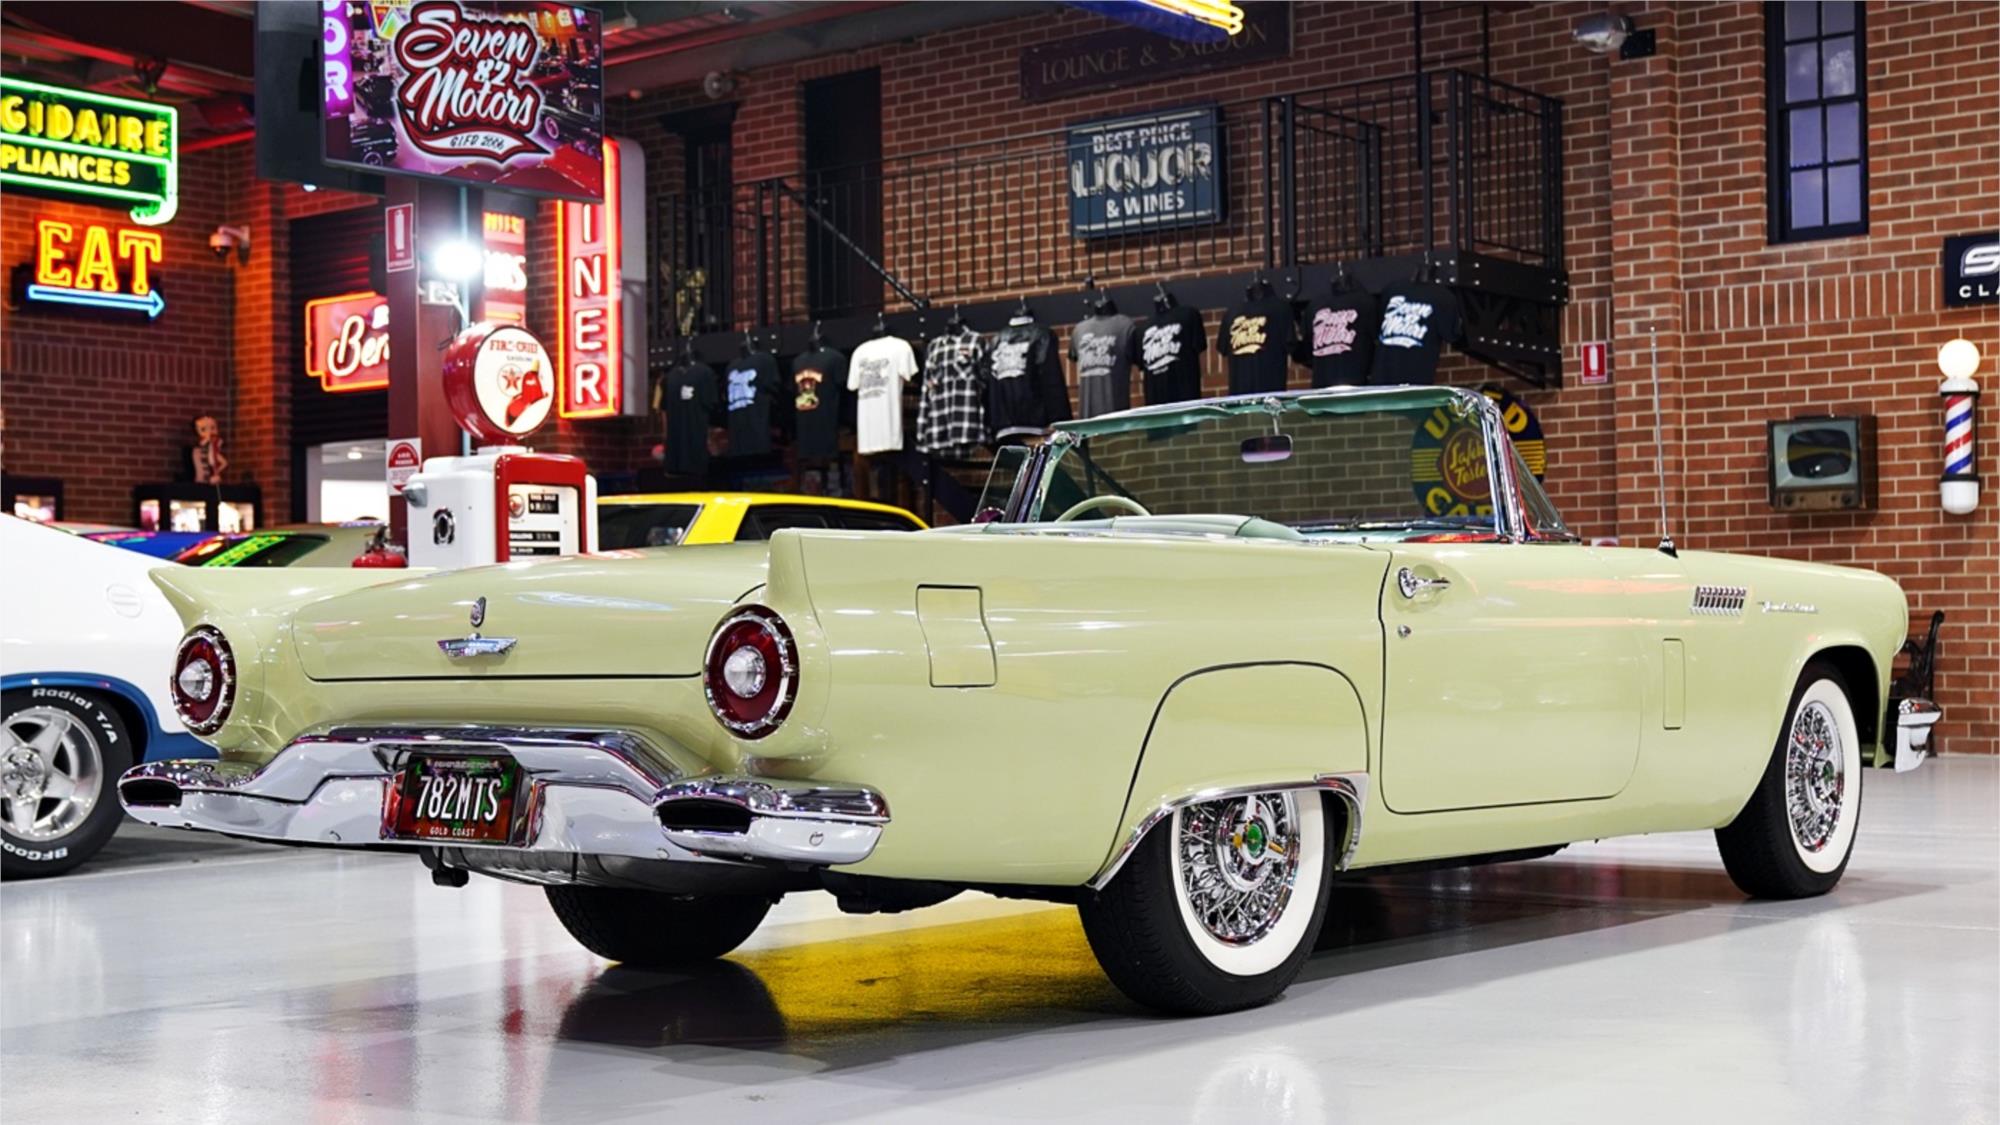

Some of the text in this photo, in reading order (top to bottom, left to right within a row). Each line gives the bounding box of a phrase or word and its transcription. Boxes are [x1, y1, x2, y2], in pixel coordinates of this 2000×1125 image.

[402, 8, 531, 68] Seven
[473, 58, 509, 87] 82
[1042, 47, 1130, 84] LOUNGE
[1139, 44, 1158, 66] &
[405, 66, 535, 127] Motors
[1, 95, 169, 156] GIDAIRE
[1092, 122, 1192, 154] BEST PRICE
[1, 143, 131, 186] PLIANCES
[1071, 142, 1212, 198] LIQUOR
[1106, 190, 1185, 219] & WINES
[38, 220, 162, 295] EAT
[1959, 284, 2000, 298] CL
[32, 687, 119, 744] Radial T/A
[416, 775, 502, 822] 782MTS
[430, 827, 475, 837] GOLD COAST
